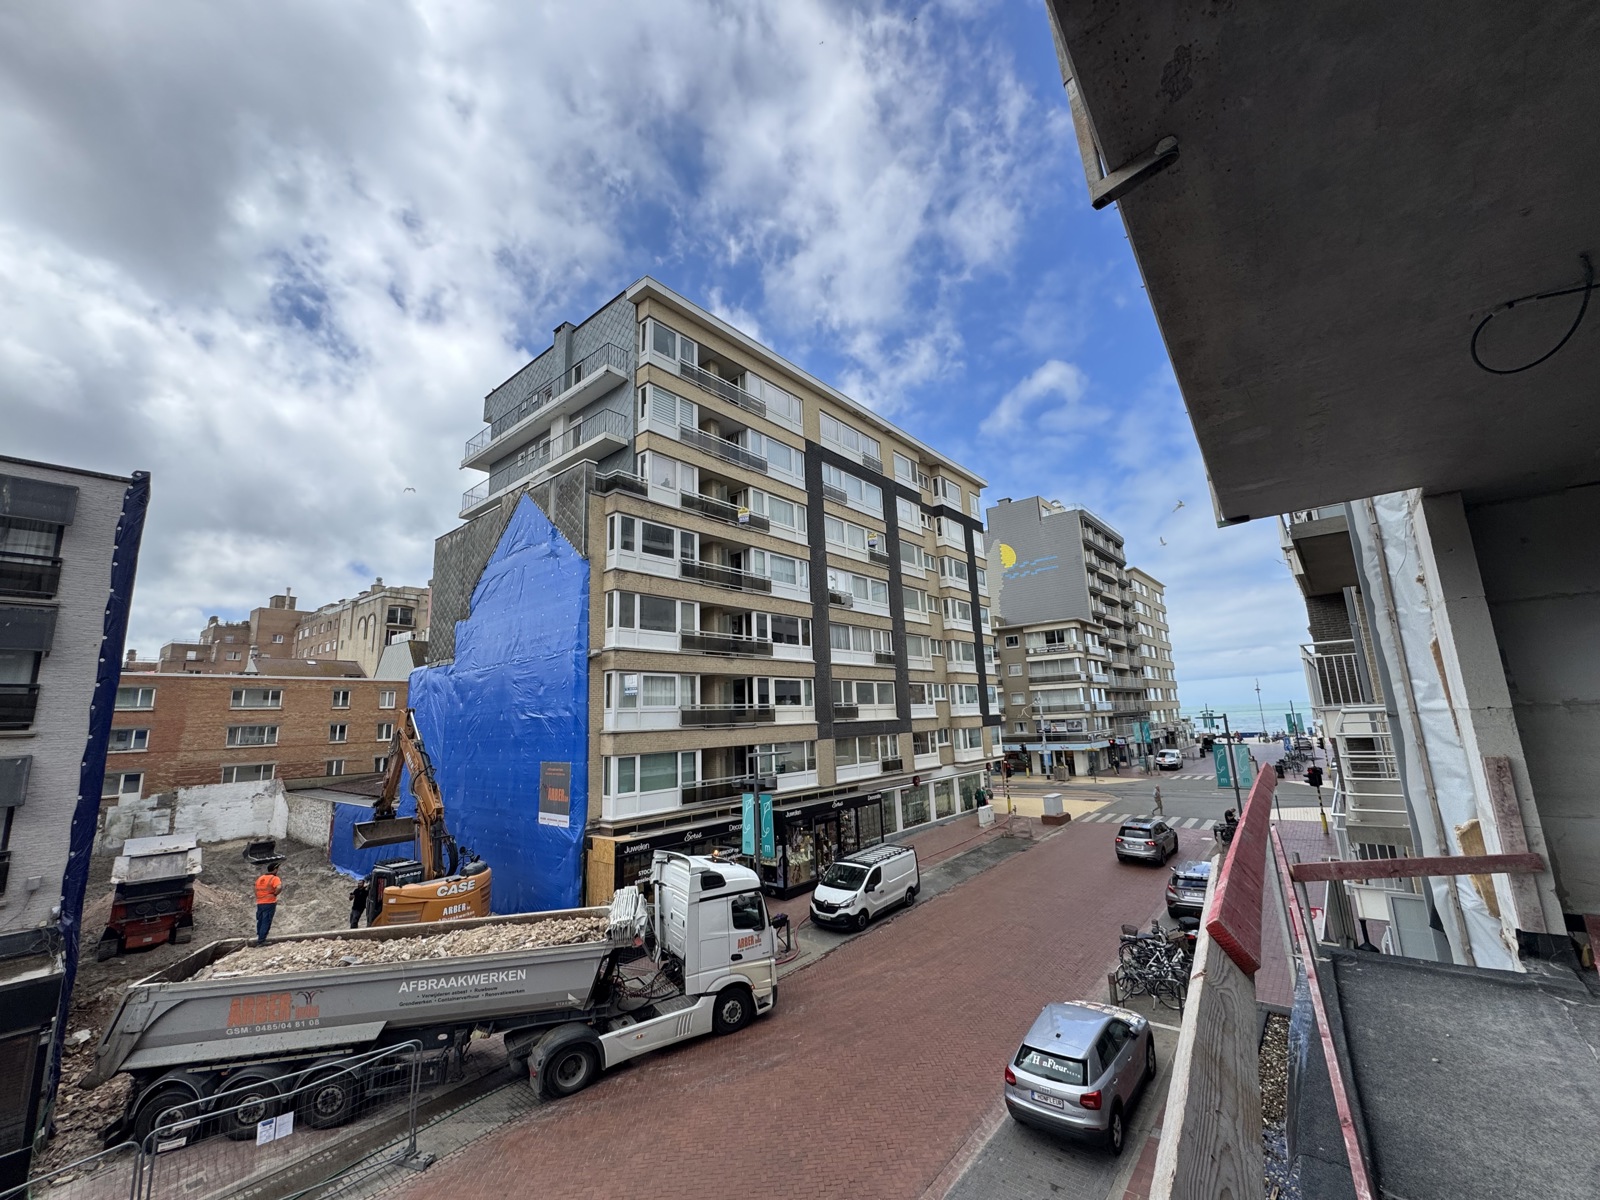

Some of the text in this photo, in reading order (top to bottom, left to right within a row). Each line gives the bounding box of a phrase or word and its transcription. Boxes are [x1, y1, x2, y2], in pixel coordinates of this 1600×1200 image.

[624, 843, 650, 854] Juwelen
[436, 880, 476, 897] CASE
[442, 902, 467, 916] ARBER
[737, 935, 755, 949] ARBER
[398, 969, 527, 994] AFBRAAKWERKEN
[226, 992, 292, 1028] ARBER
[225, 1027, 253, 1036] GSM:
[255, 1021, 292, 1033] 0485/04
